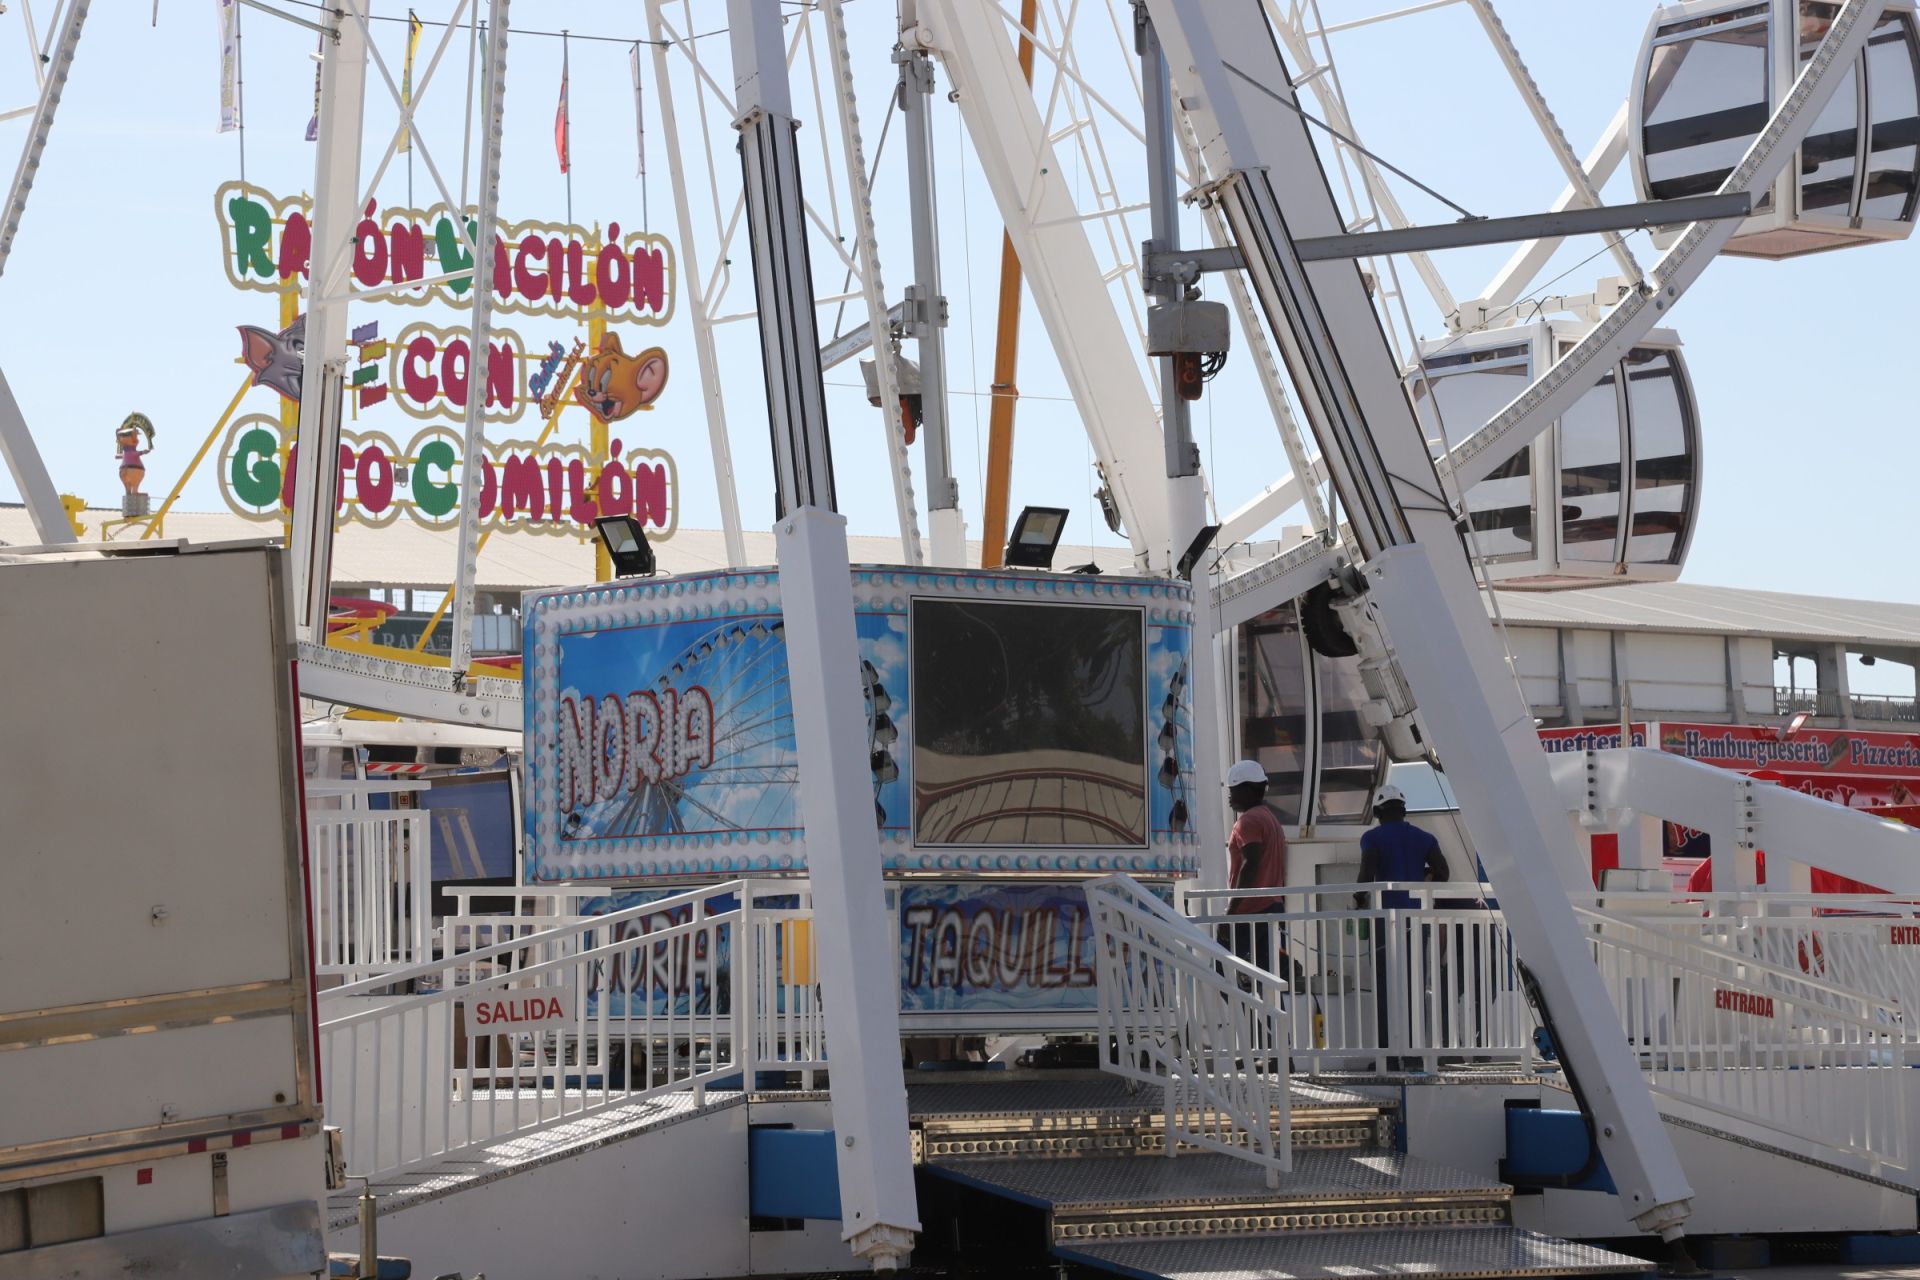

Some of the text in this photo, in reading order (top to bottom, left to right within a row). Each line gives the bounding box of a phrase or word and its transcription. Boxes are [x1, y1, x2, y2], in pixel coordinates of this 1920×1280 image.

[403, 337, 514, 409] CON
[560, 685, 714, 814] NORIA
[1684, 730, 1920, 768] Hamburgueseria Pizzeria
[476, 997, 564, 1025] SALIDA
[1715, 989, 1774, 1018] ENTRADA
